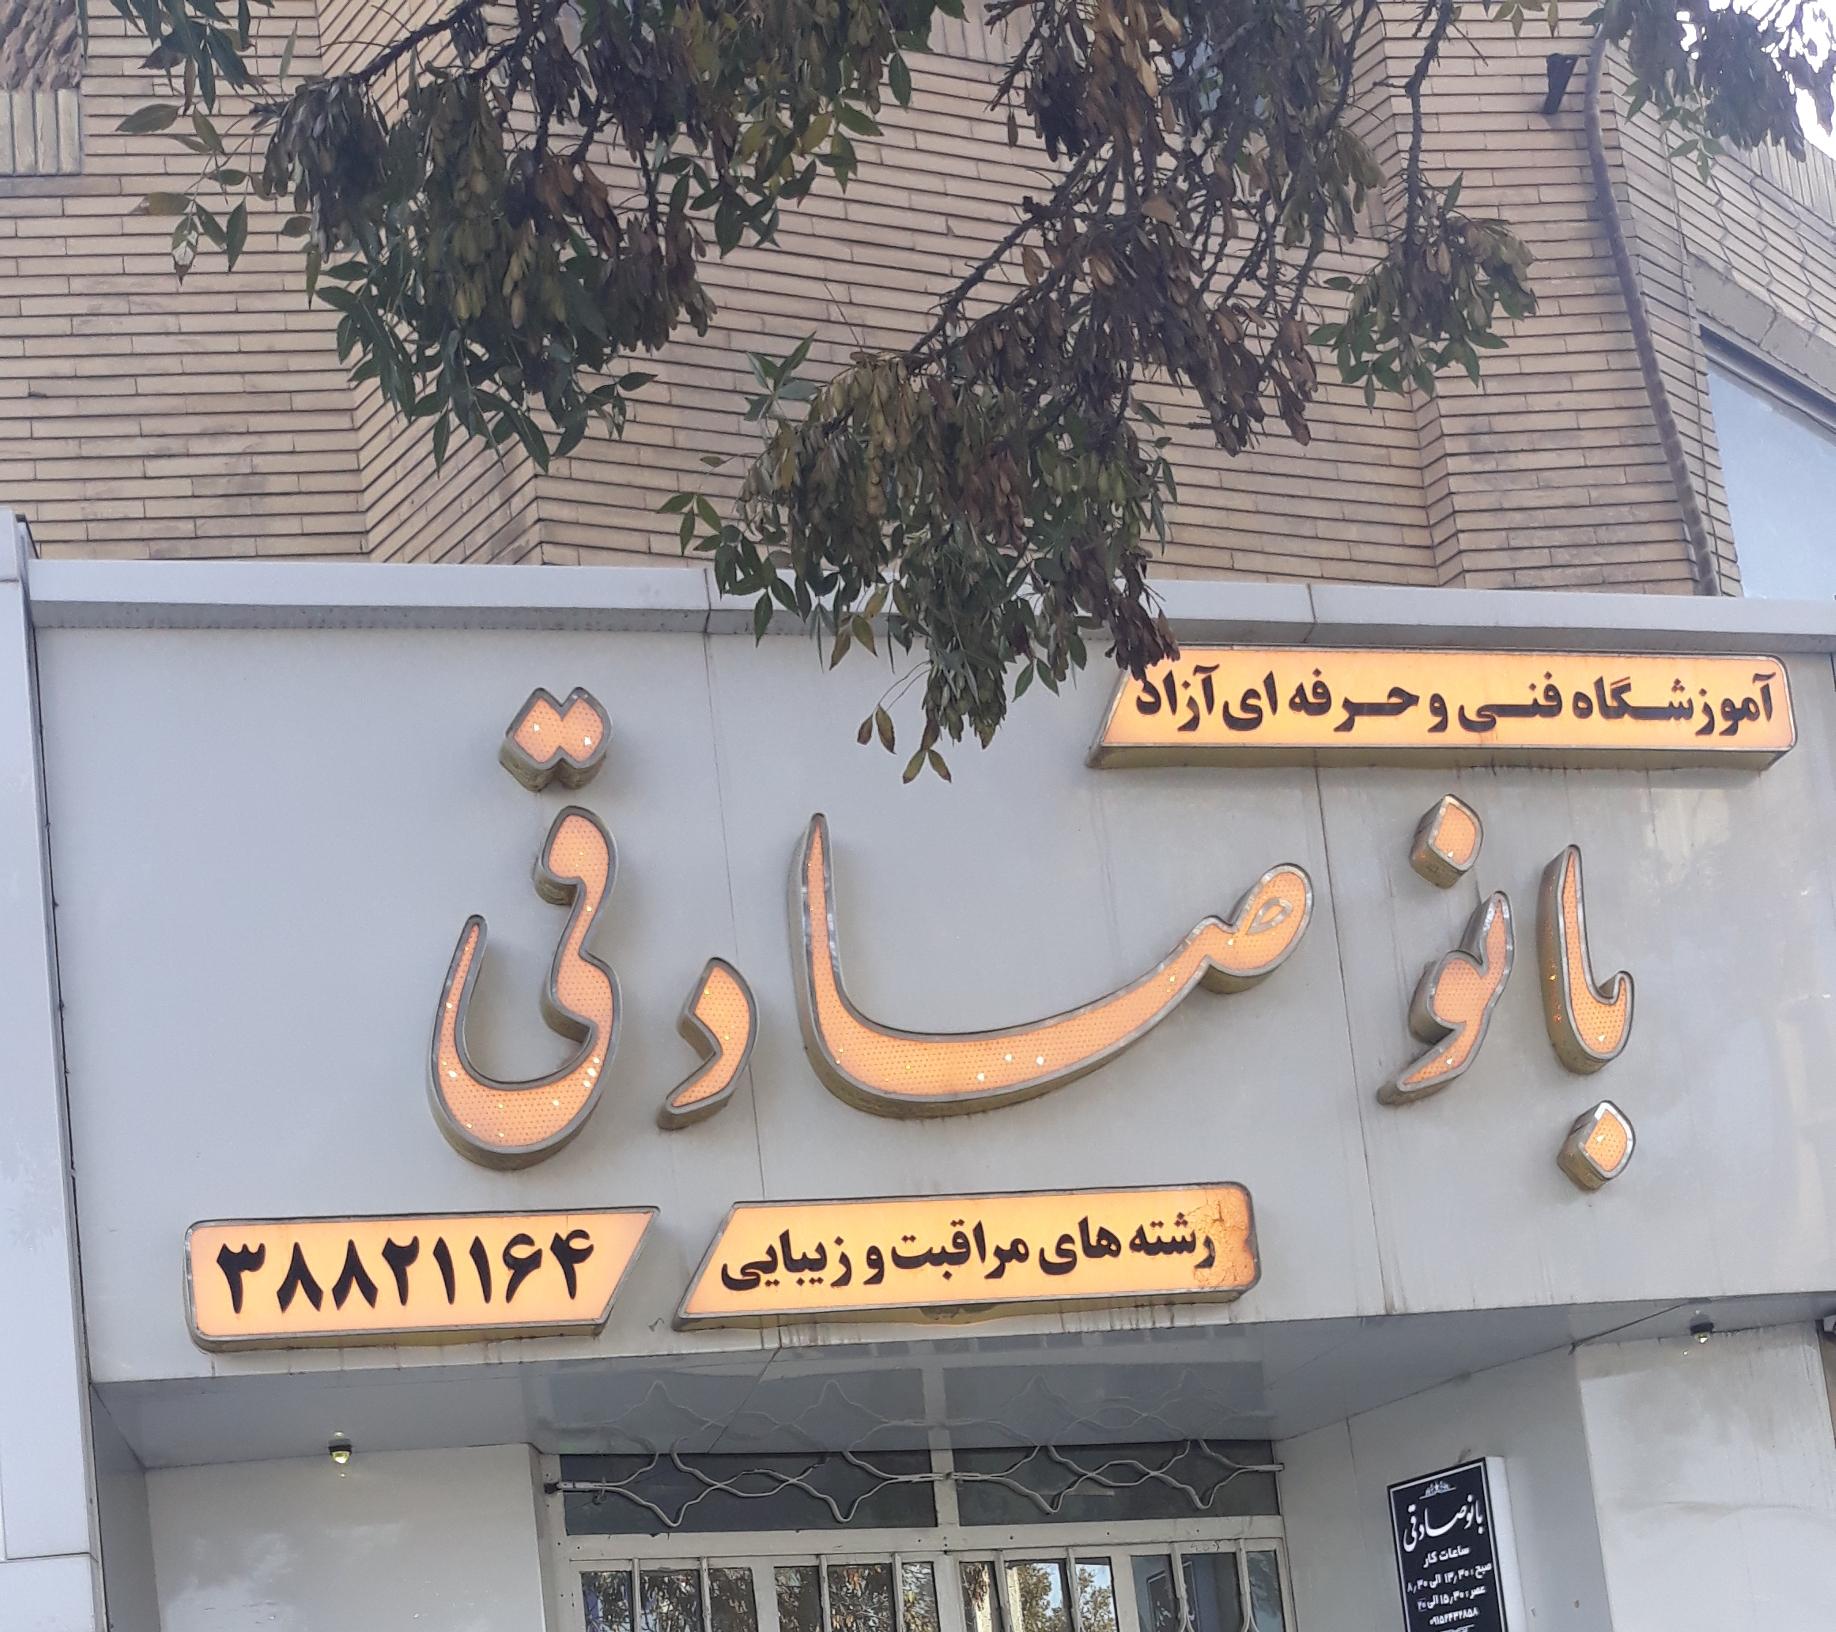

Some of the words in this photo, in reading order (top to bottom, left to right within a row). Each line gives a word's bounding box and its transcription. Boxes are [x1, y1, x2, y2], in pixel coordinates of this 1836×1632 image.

[1135, 663, 1220, 732] آزاد
[1222, 670, 1278, 731] ای
[1288, 667, 1420, 732] حرفه
[1427, 693, 1449, 732] و
[1458, 671, 1563, 733] فنی
[1572, 672, 1776, 736] آموزشگاه
[428, 687, 1315, 1170] صادقی
[1377, 793, 1636, 1190] بانو
[720, 1228, 852, 1292] زیبایی
[863, 1245, 885, 1285] و
[890, 1218, 1030, 1280] مراقبت
[1038, 1215, 1122, 1276] های
[1128, 1211, 1216, 1269] رشته
[216, 1229, 594, 1315] ۳۸۸۲۱۱۶۴
[1403, 1503, 1467, 1552] صادقی
[1463, 1494, 1484, 1535] بانو
[1423, 1551, 1438, 1568] کار
[1439, 1545, 1470, 1561] ساعات
